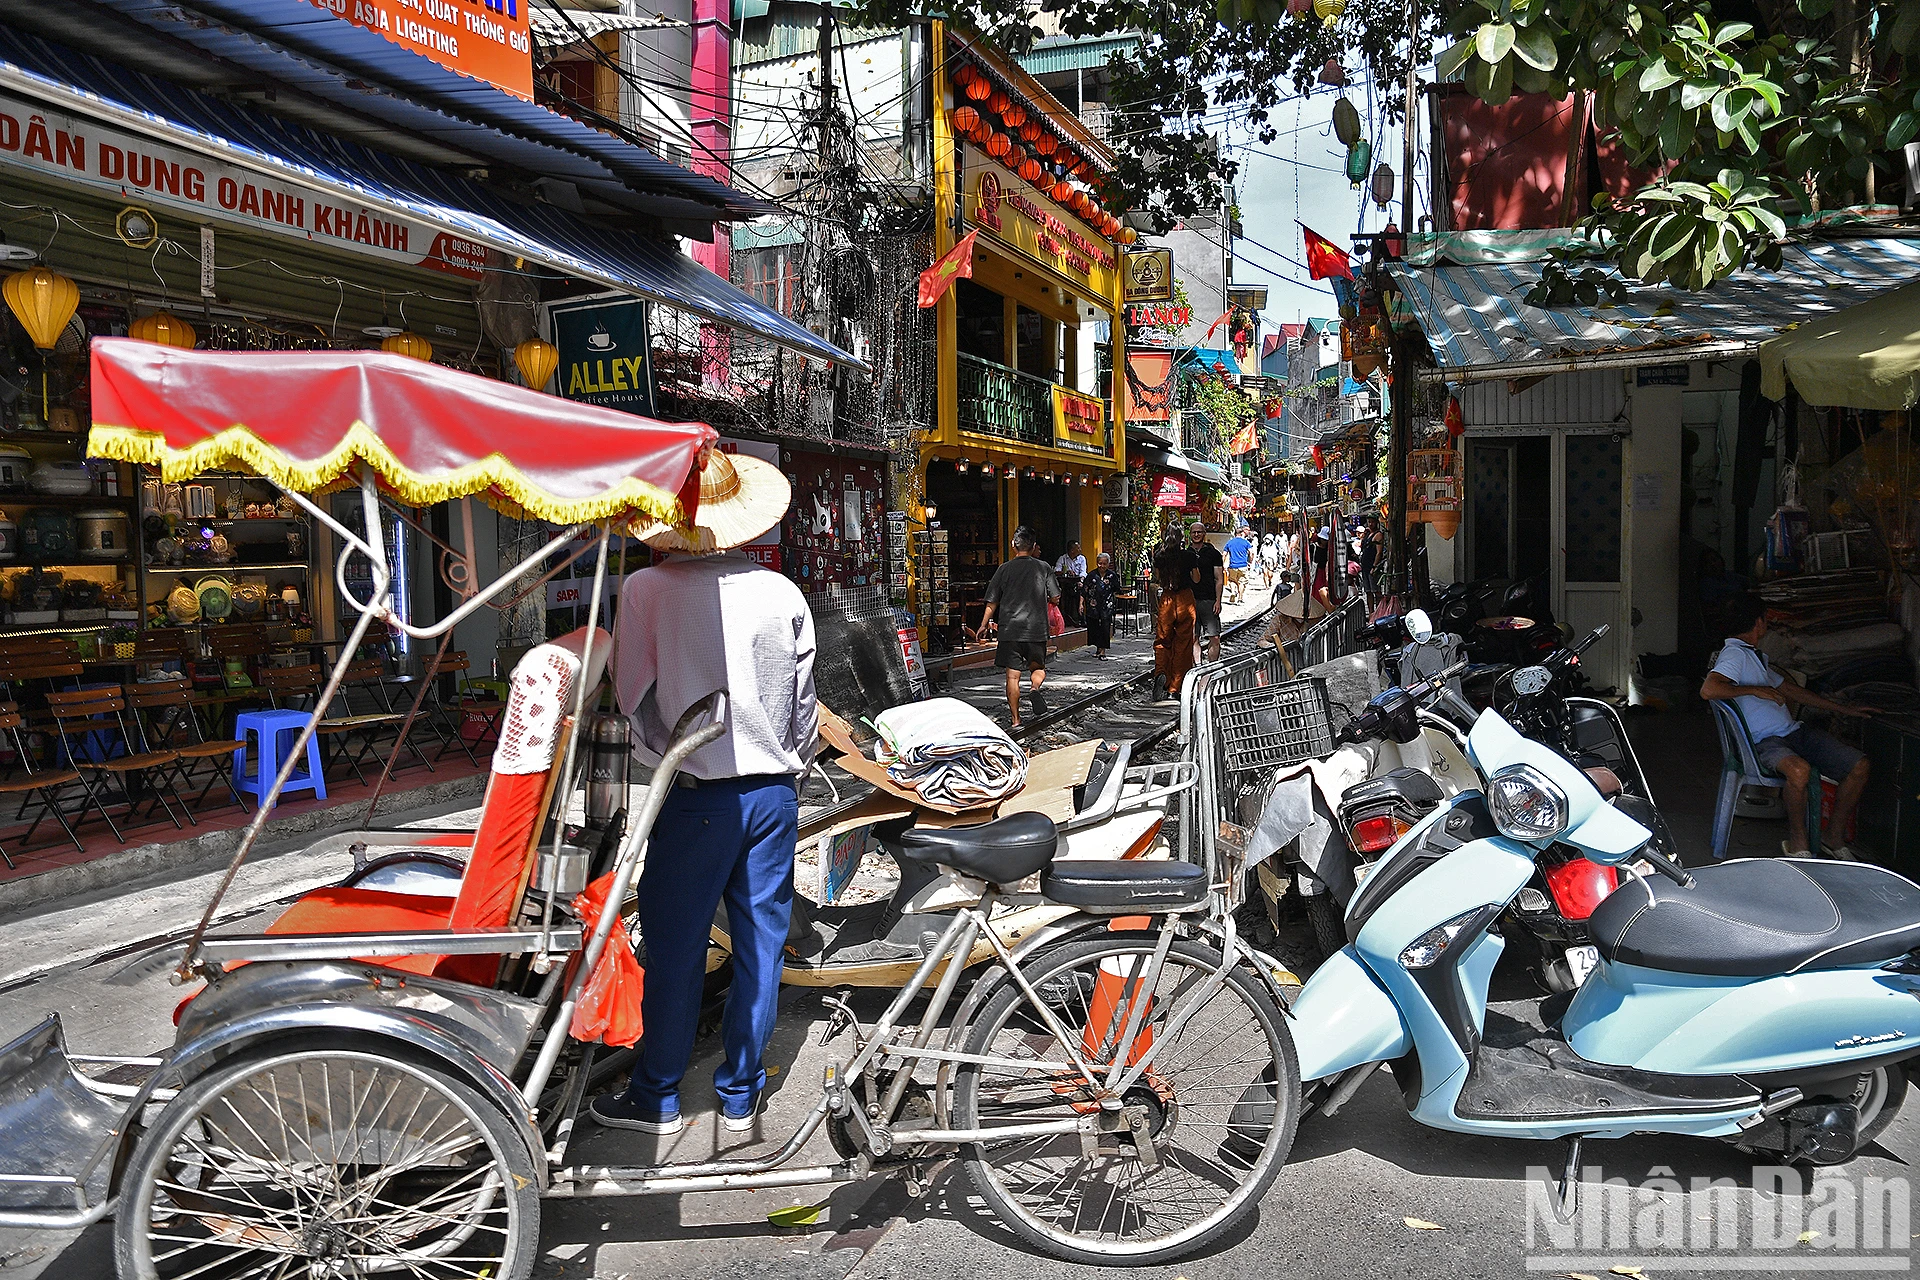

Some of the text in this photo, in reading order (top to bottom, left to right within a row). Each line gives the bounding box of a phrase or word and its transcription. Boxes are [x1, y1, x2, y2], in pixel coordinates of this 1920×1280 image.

[354, 0, 390, 32] ASIA
[396, 15, 459, 58] LIGHTING
[464, 12, 505, 45] THÔNG
[509, 32, 529, 54] GIÓ
[0, 113, 85, 172] DÂN
[217, 177, 304, 229] OANH
[314, 203, 409, 252] KHÁNH
[452, 239, 486, 258] 0936 534
[568, 356, 643, 395] ALLEY
[574, 394, 645, 405] Coffee House
[556, 588, 580, 603] SAPA
[1351, 780, 1385, 795] HONDA
